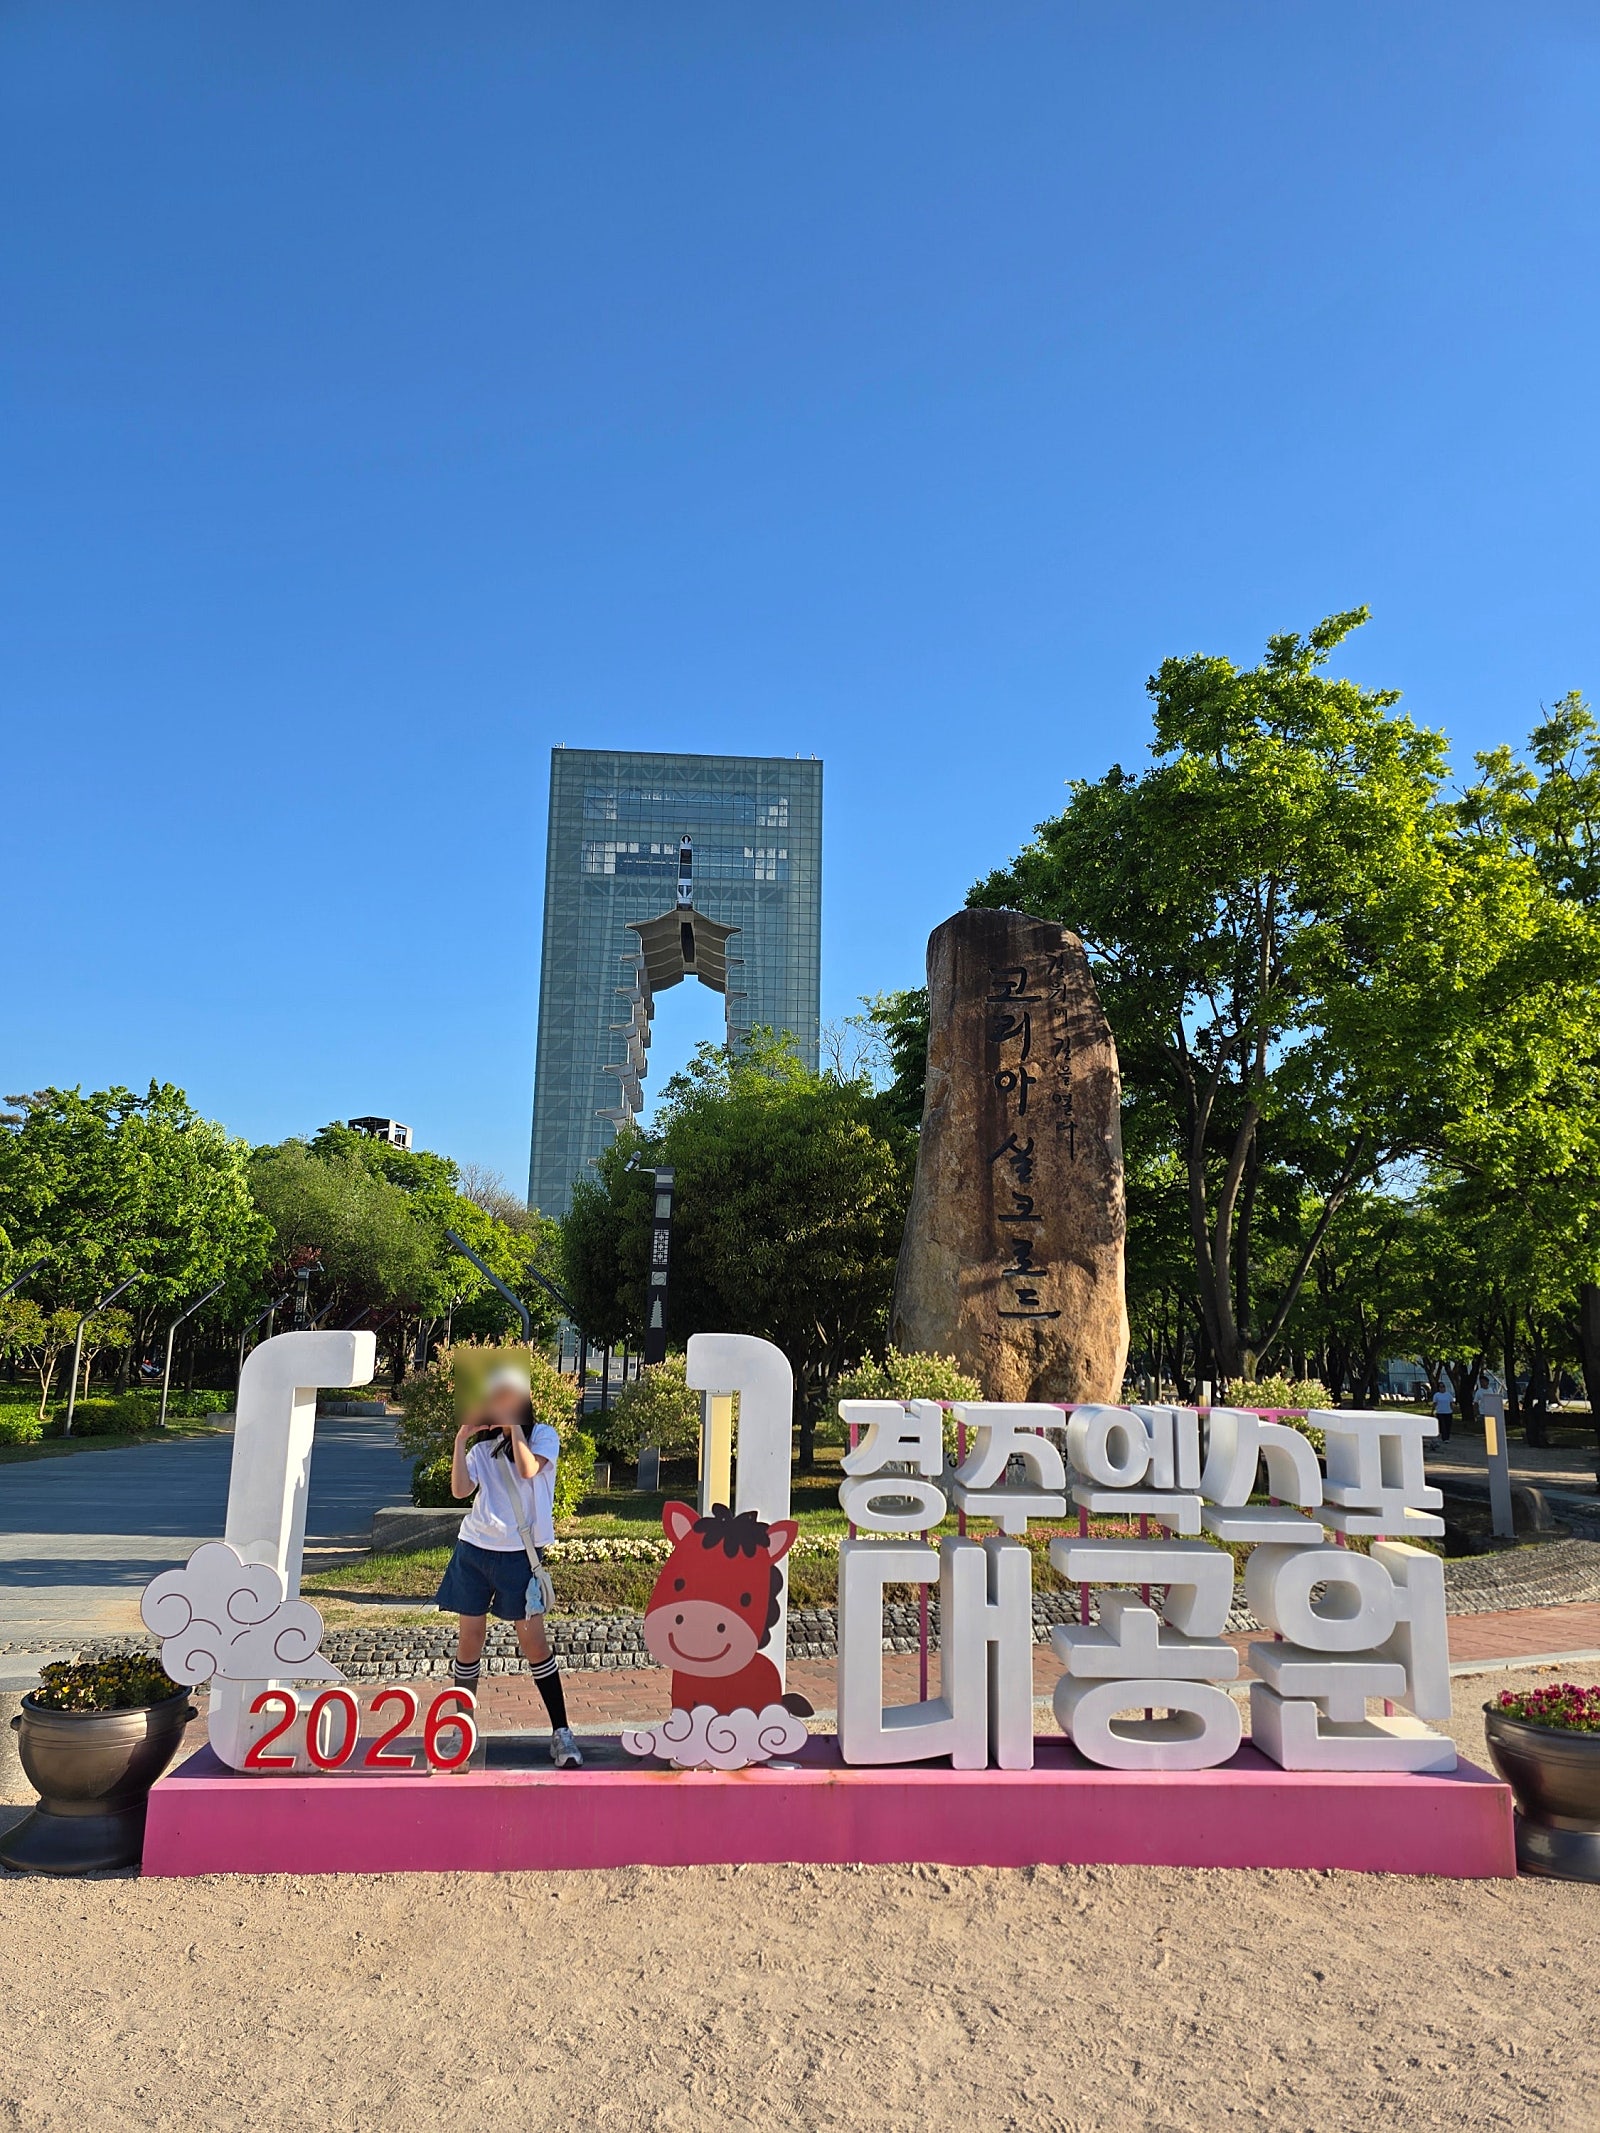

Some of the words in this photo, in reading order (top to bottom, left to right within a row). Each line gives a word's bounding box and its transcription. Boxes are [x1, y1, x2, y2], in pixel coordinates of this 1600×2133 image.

[986, 966, 1042, 1116] 코리아
[1052, 1035, 1072, 1086] 길을
[1052, 1093, 1078, 1161] 열다
[987, 1133, 1062, 1320] 실크로드
[838, 1398, 1445, 1544] 경주엑스포
[837, 1536, 1458, 1772] 대공원
[244, 1686, 478, 1770] 2026
